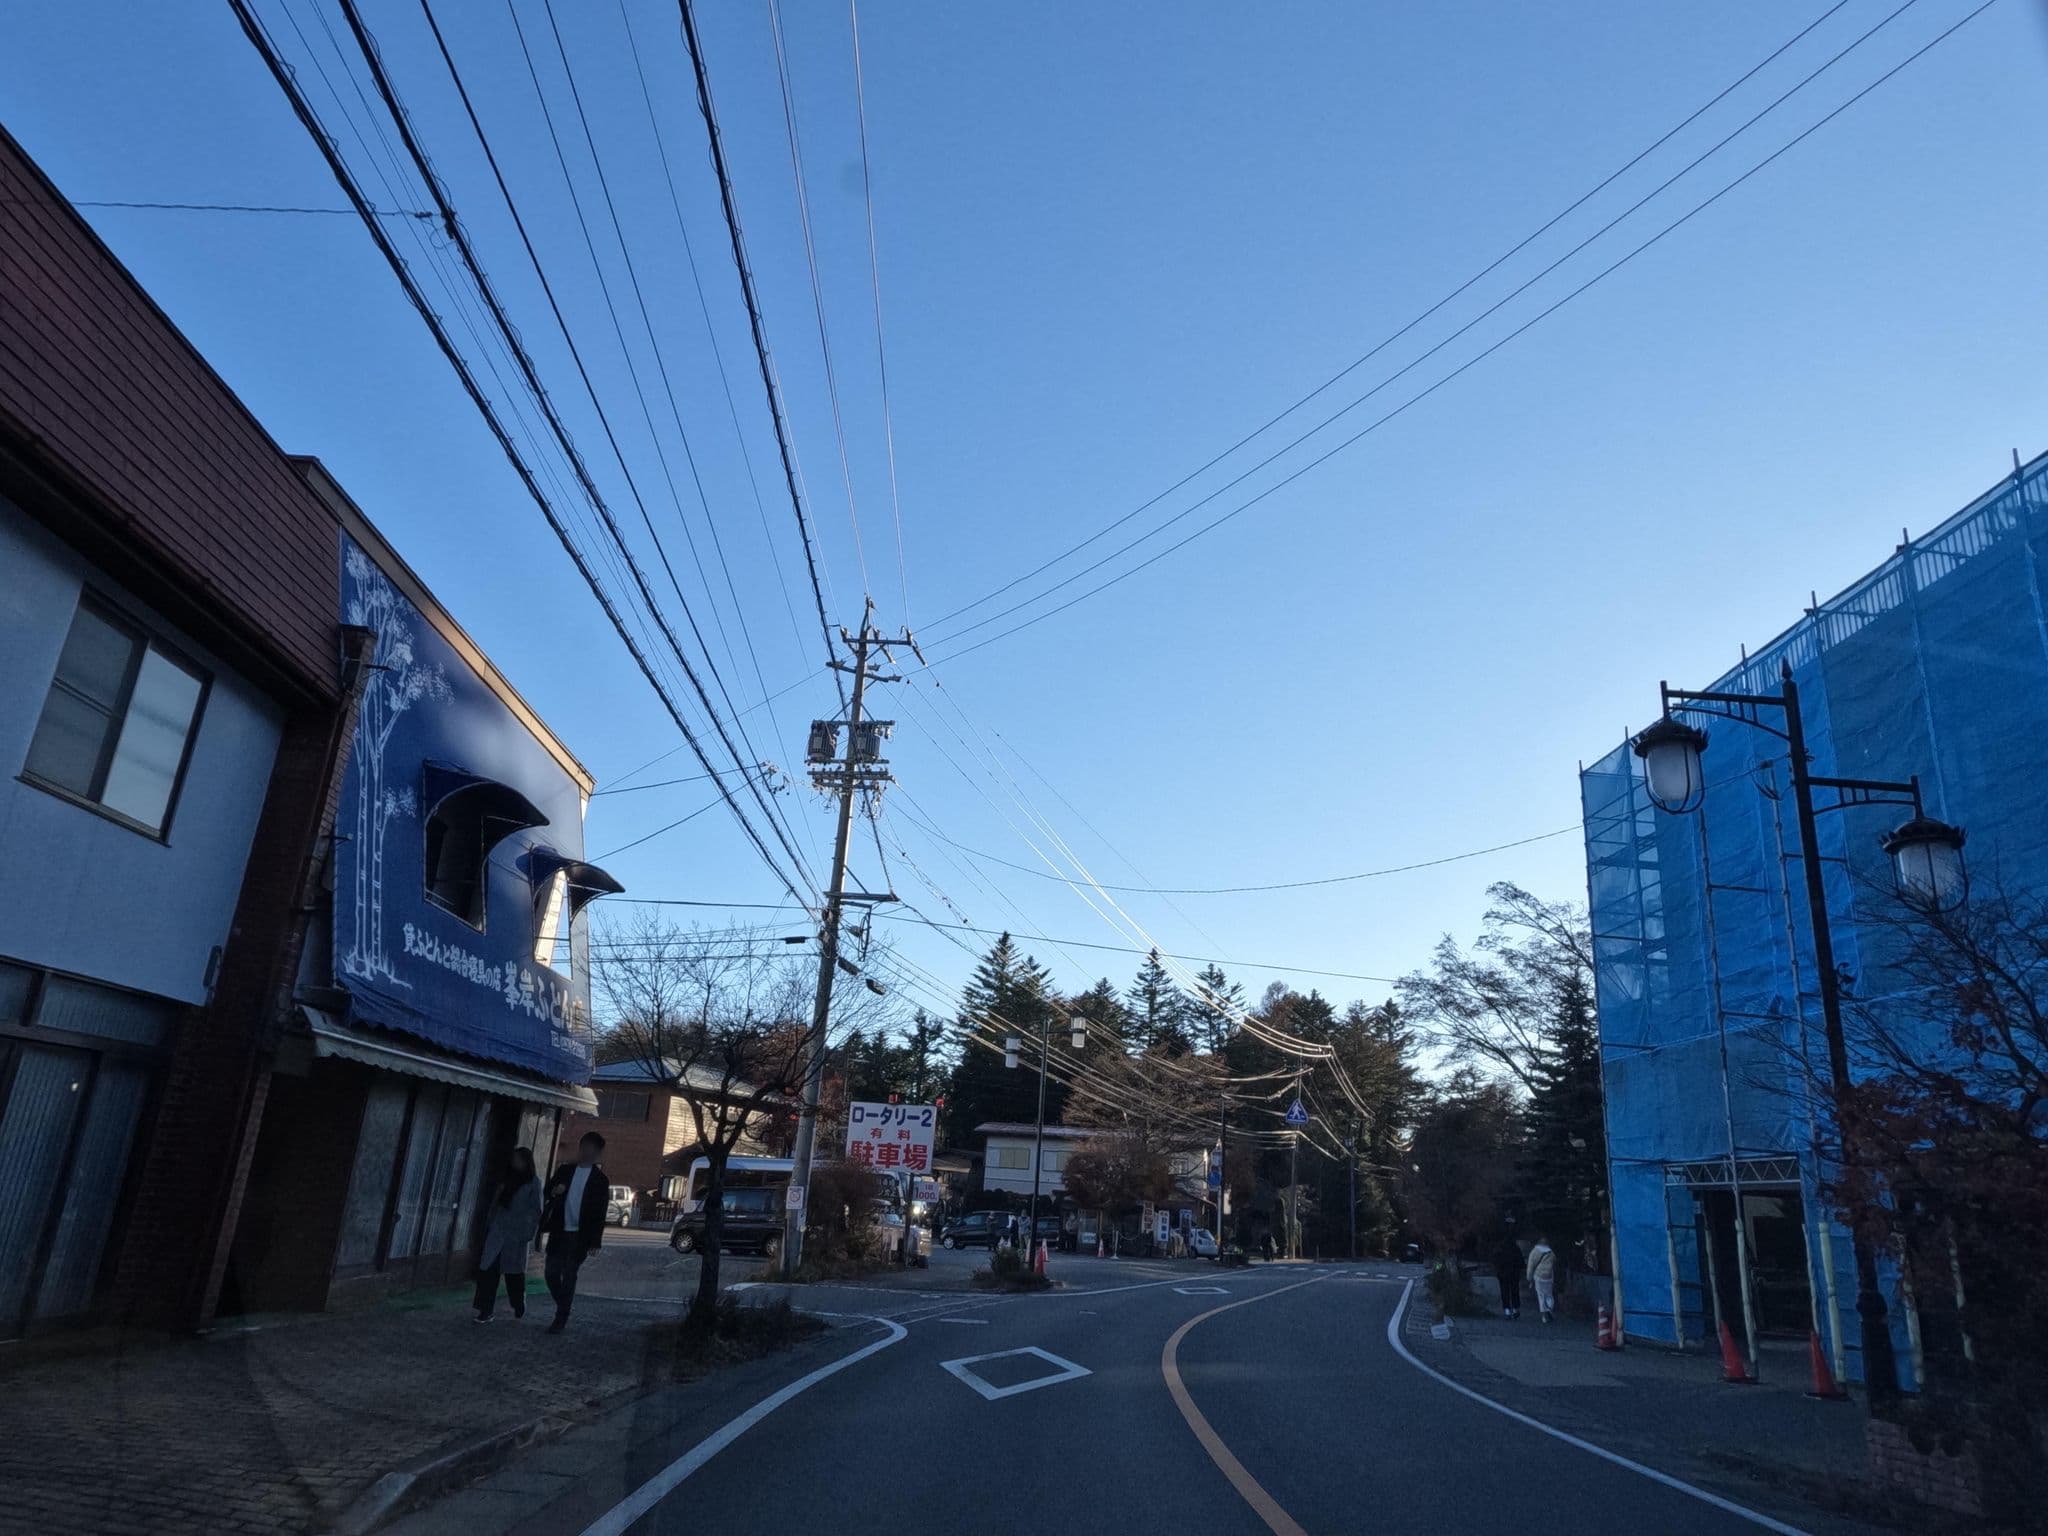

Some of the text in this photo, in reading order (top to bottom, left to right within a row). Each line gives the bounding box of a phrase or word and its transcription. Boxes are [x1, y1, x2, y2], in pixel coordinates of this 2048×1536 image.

[852, 1106, 932, 1127] ロータリー2
[870, 1127, 911, 1141] 有料
[850, 1141, 928, 1170] 駐車場
